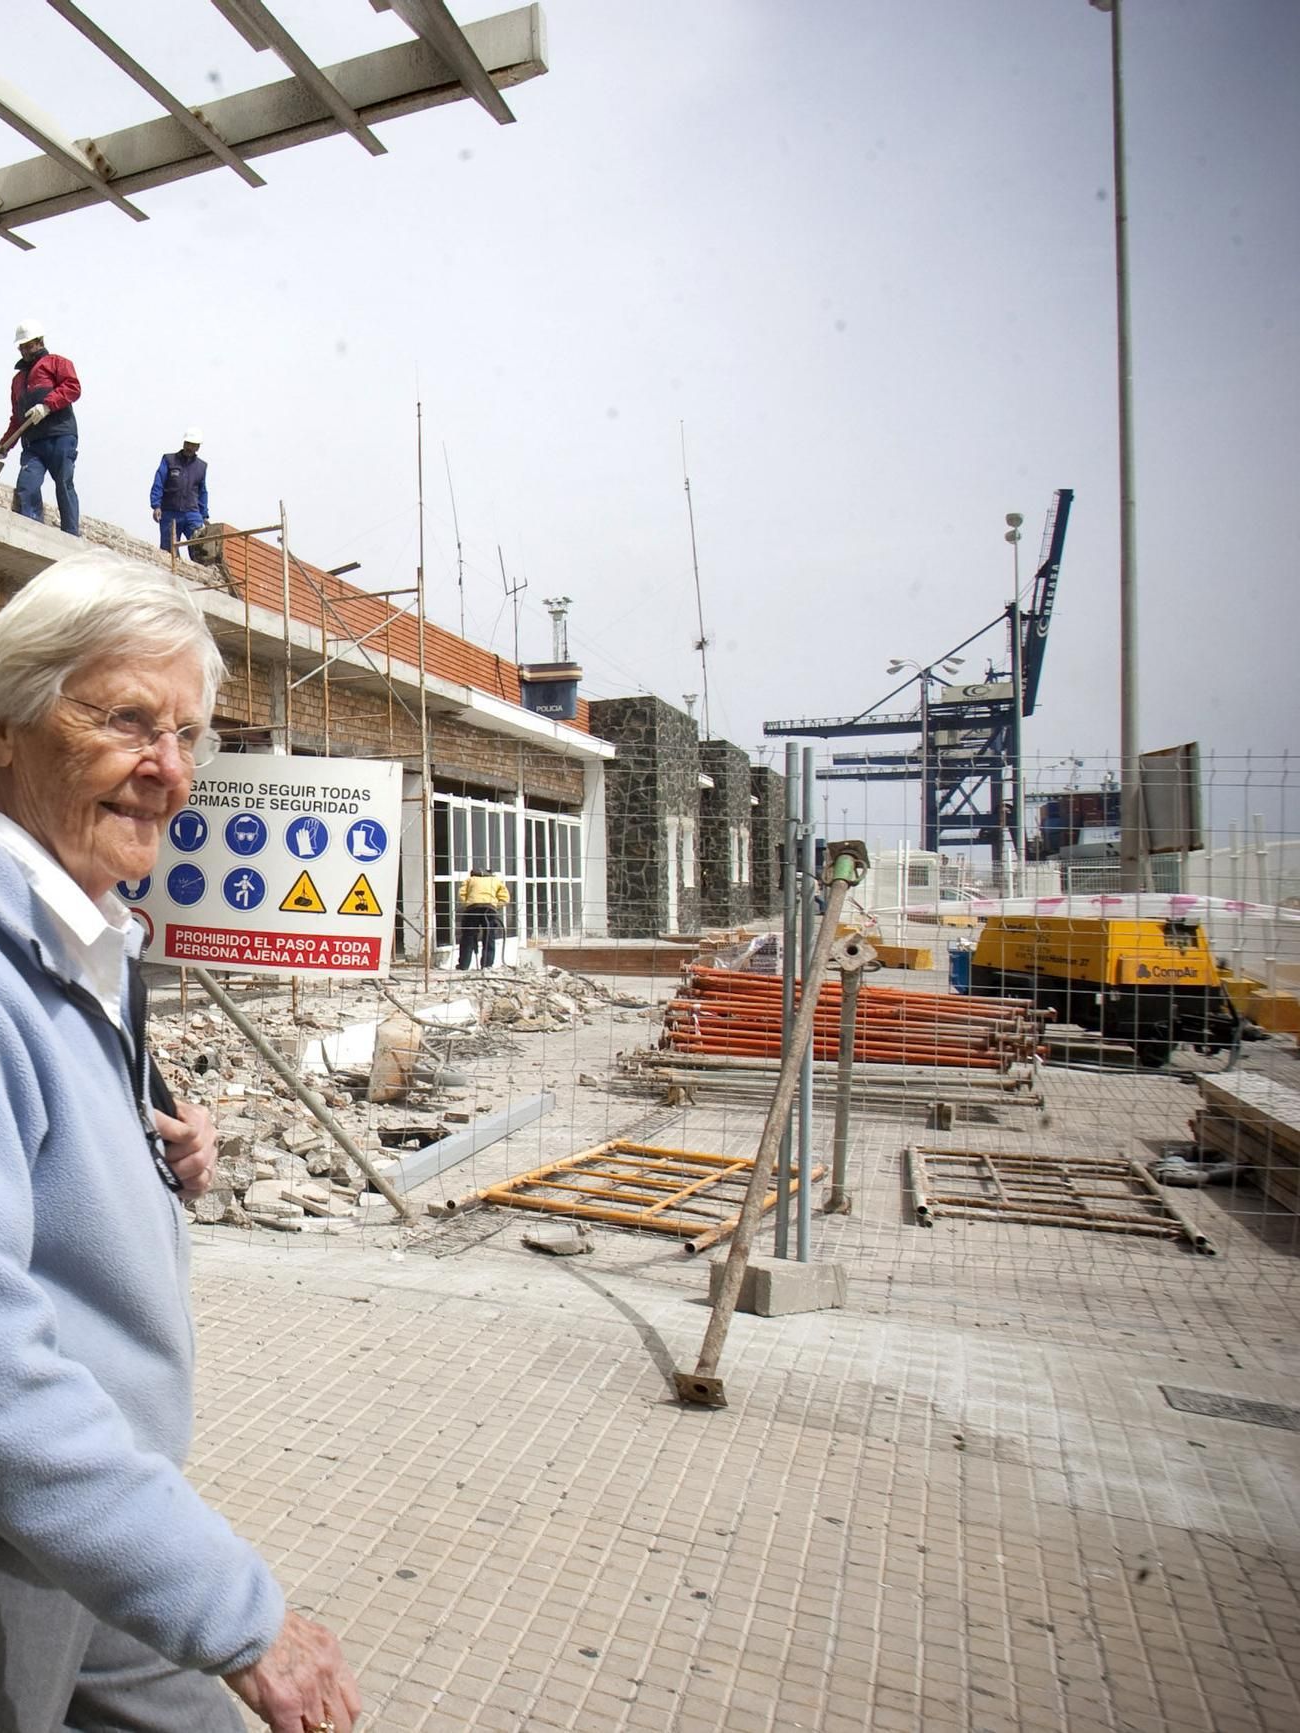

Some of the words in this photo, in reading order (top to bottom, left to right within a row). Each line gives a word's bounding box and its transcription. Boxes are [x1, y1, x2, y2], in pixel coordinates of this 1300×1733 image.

[190, 780, 254, 794] GATORIO
[258, 783, 316, 798] SEGUIR
[320, 786, 371, 801] TODAS
[188, 794, 240, 808] ORMAS
[245, 797, 265, 809] DE
[269, 798, 359, 815] SEGURIDAD
[175, 930, 250, 947] PROHIBIDO
[254, 936, 272, 949] EL
[276, 938, 316, 952] PASO
[319, 940, 330, 952] A
[333, 941, 371, 953] TODA
[175, 942, 239, 959] PERSONA
[243, 948, 291, 962] AJENA
[294, 952, 305, 963] A
[308, 953, 328, 965] LA
[331, 953, 370, 966] OBRA
[1151, 965, 1199, 979] CompAir
